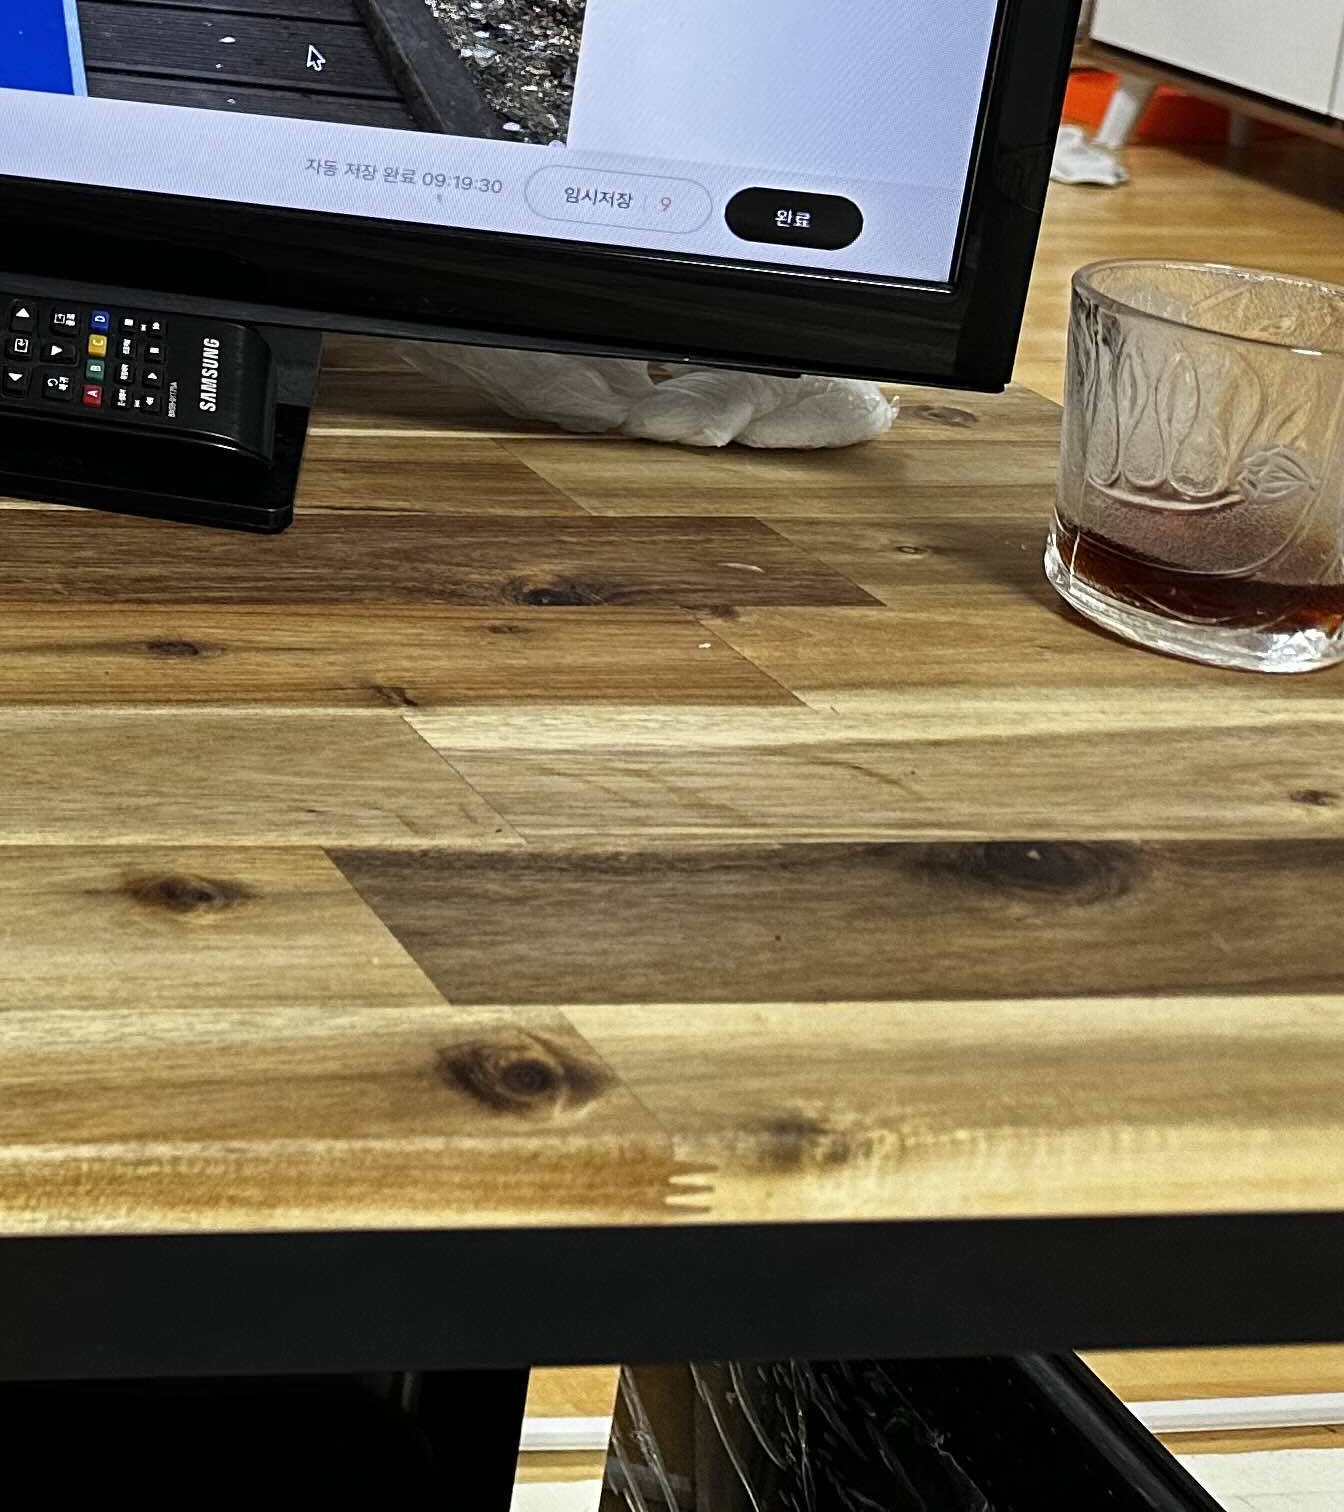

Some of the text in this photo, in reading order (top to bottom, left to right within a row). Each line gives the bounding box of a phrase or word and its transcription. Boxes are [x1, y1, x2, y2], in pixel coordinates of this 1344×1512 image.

[305, 158, 503, 194] 자동 저장 완료 09:19:30
[564, 186, 672, 212] 임시저장 9
[774, 209, 811, 228] 완료
[95, 315, 106, 324] D
[90, 365, 101, 374] B
[199, 338, 221, 412] SAMSUNG
[87, 390, 99, 399] A
